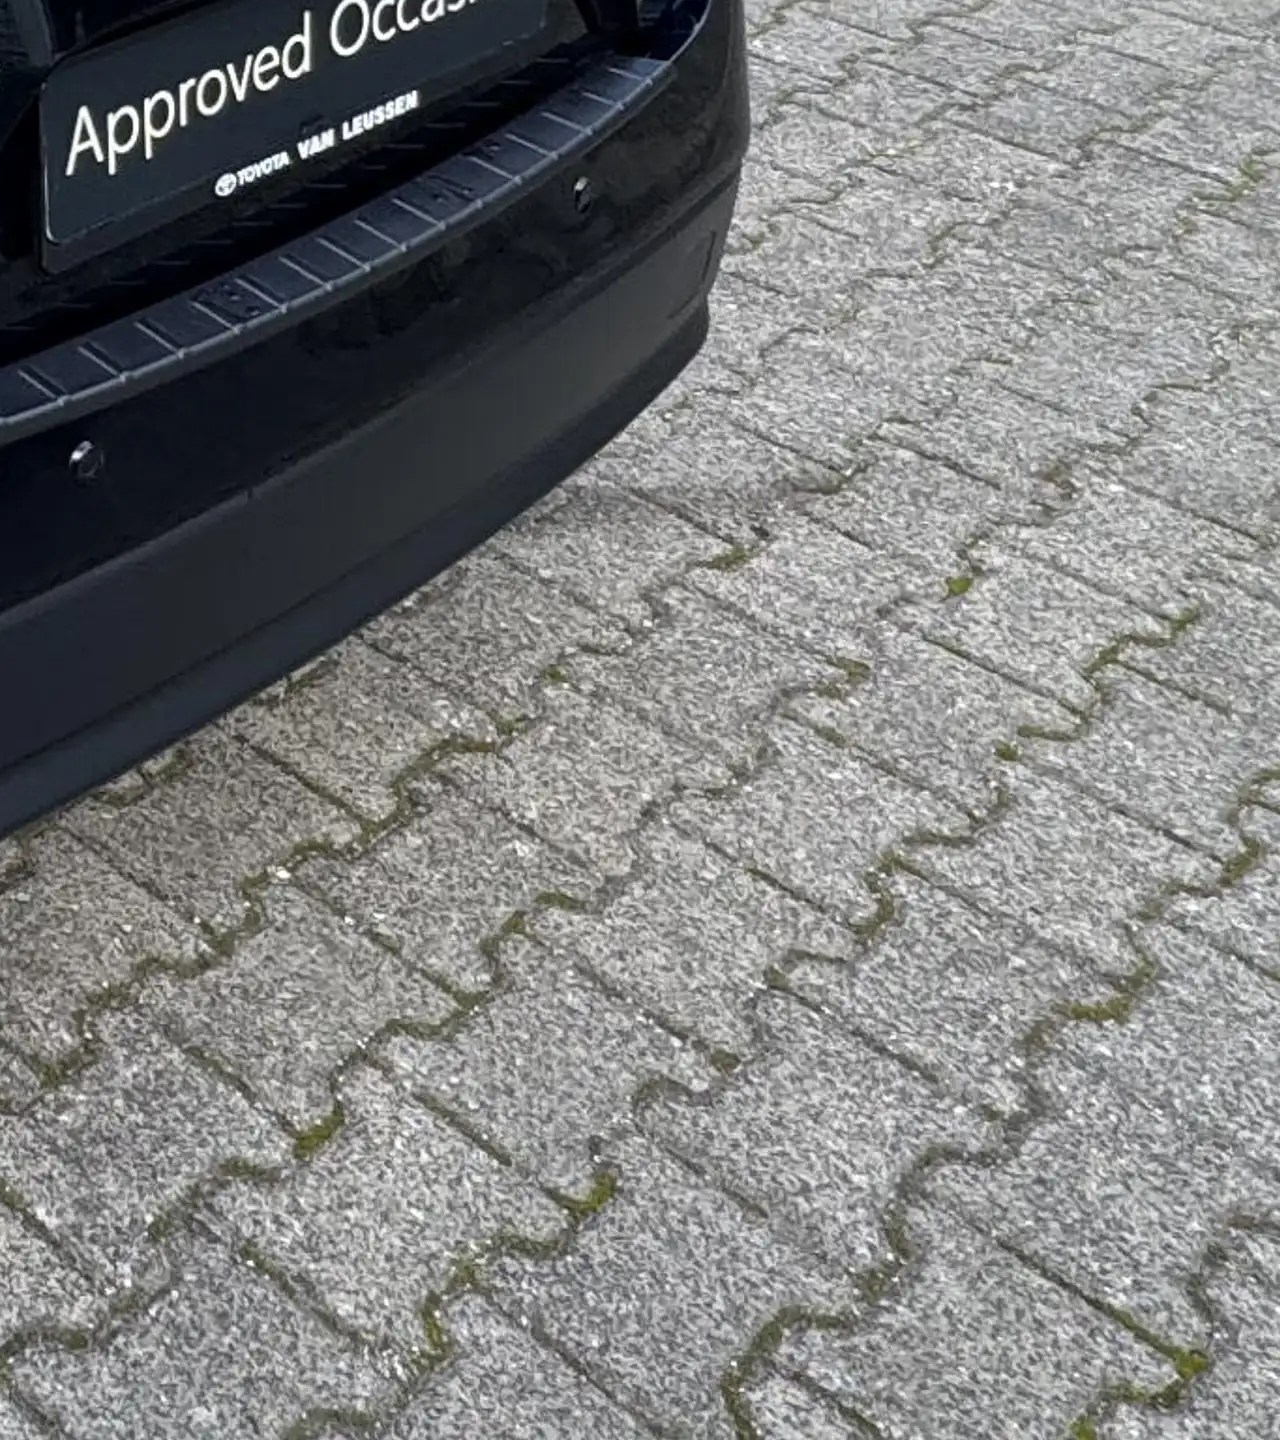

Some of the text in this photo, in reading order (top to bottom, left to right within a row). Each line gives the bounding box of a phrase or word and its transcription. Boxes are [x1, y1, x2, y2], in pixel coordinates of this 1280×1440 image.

[64, 8, 312, 177] Approved
[237, 90, 419, 185] TOYOTA VAN LEUSSEN
